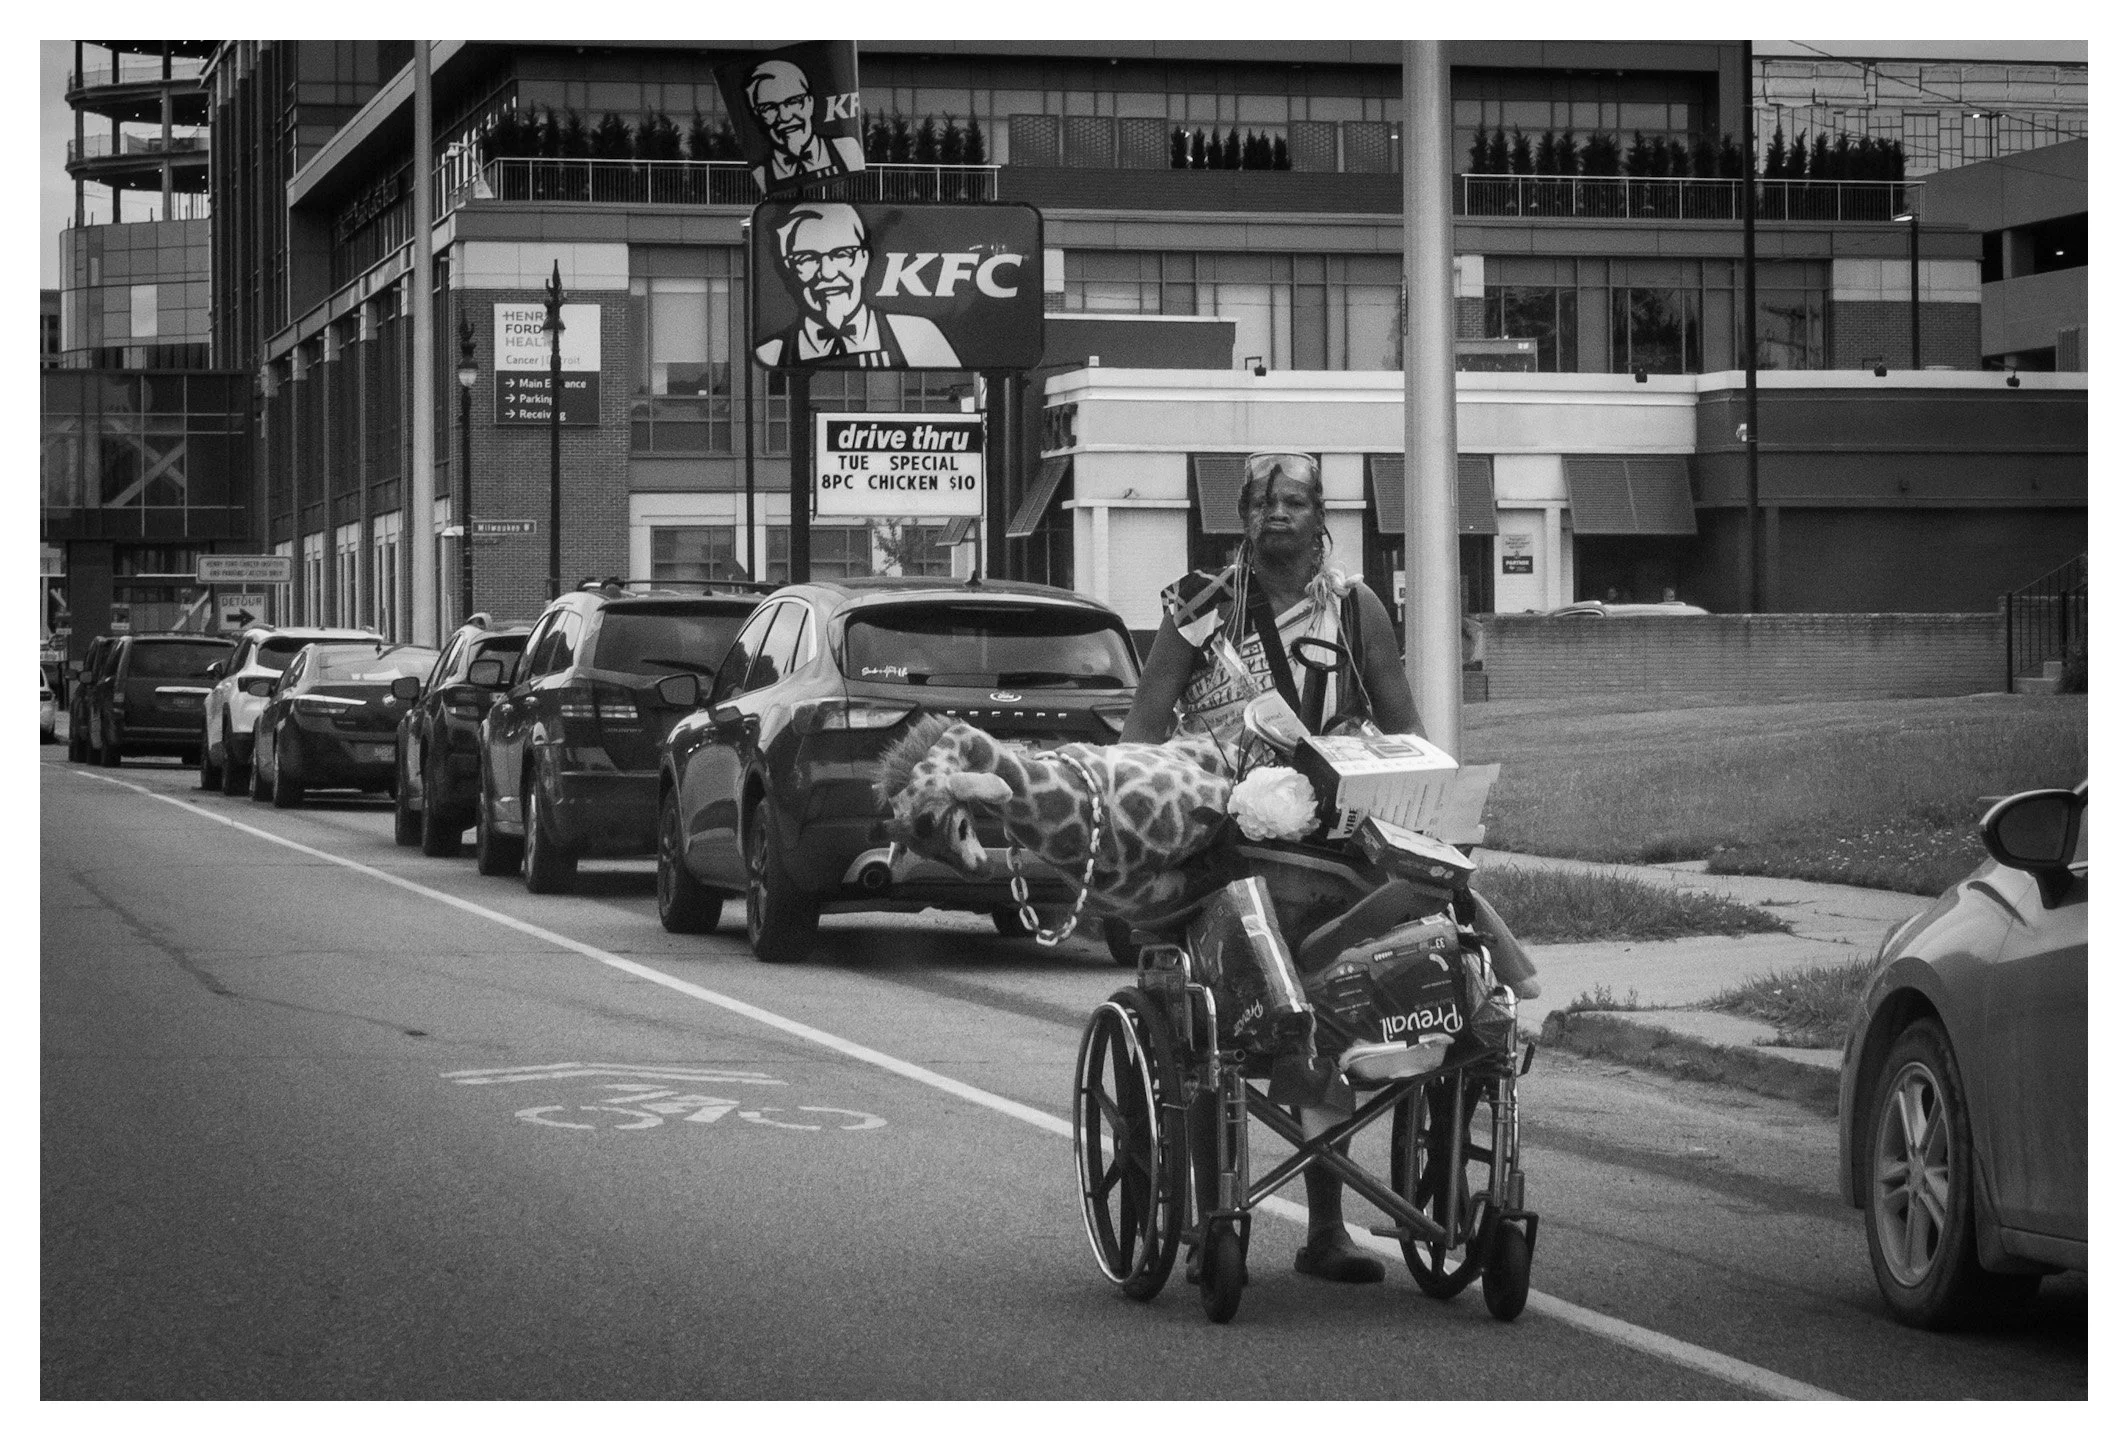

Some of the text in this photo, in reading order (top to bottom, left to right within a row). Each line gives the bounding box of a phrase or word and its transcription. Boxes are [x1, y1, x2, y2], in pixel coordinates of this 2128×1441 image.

[875, 252, 1023, 298] KFC
[505, 323, 542, 334] FORD
[506, 355, 538, 365] Cancer
[519, 378, 543, 389] Main
[838, 423, 970, 451] drive thru
[838, 455, 959, 471] TUE SPECIAL
[821, 474, 976, 491] 8PC CHICKEN $10
[221, 597, 263, 607] DETOUR
[1382, 1003, 1464, 1043] Prevail
